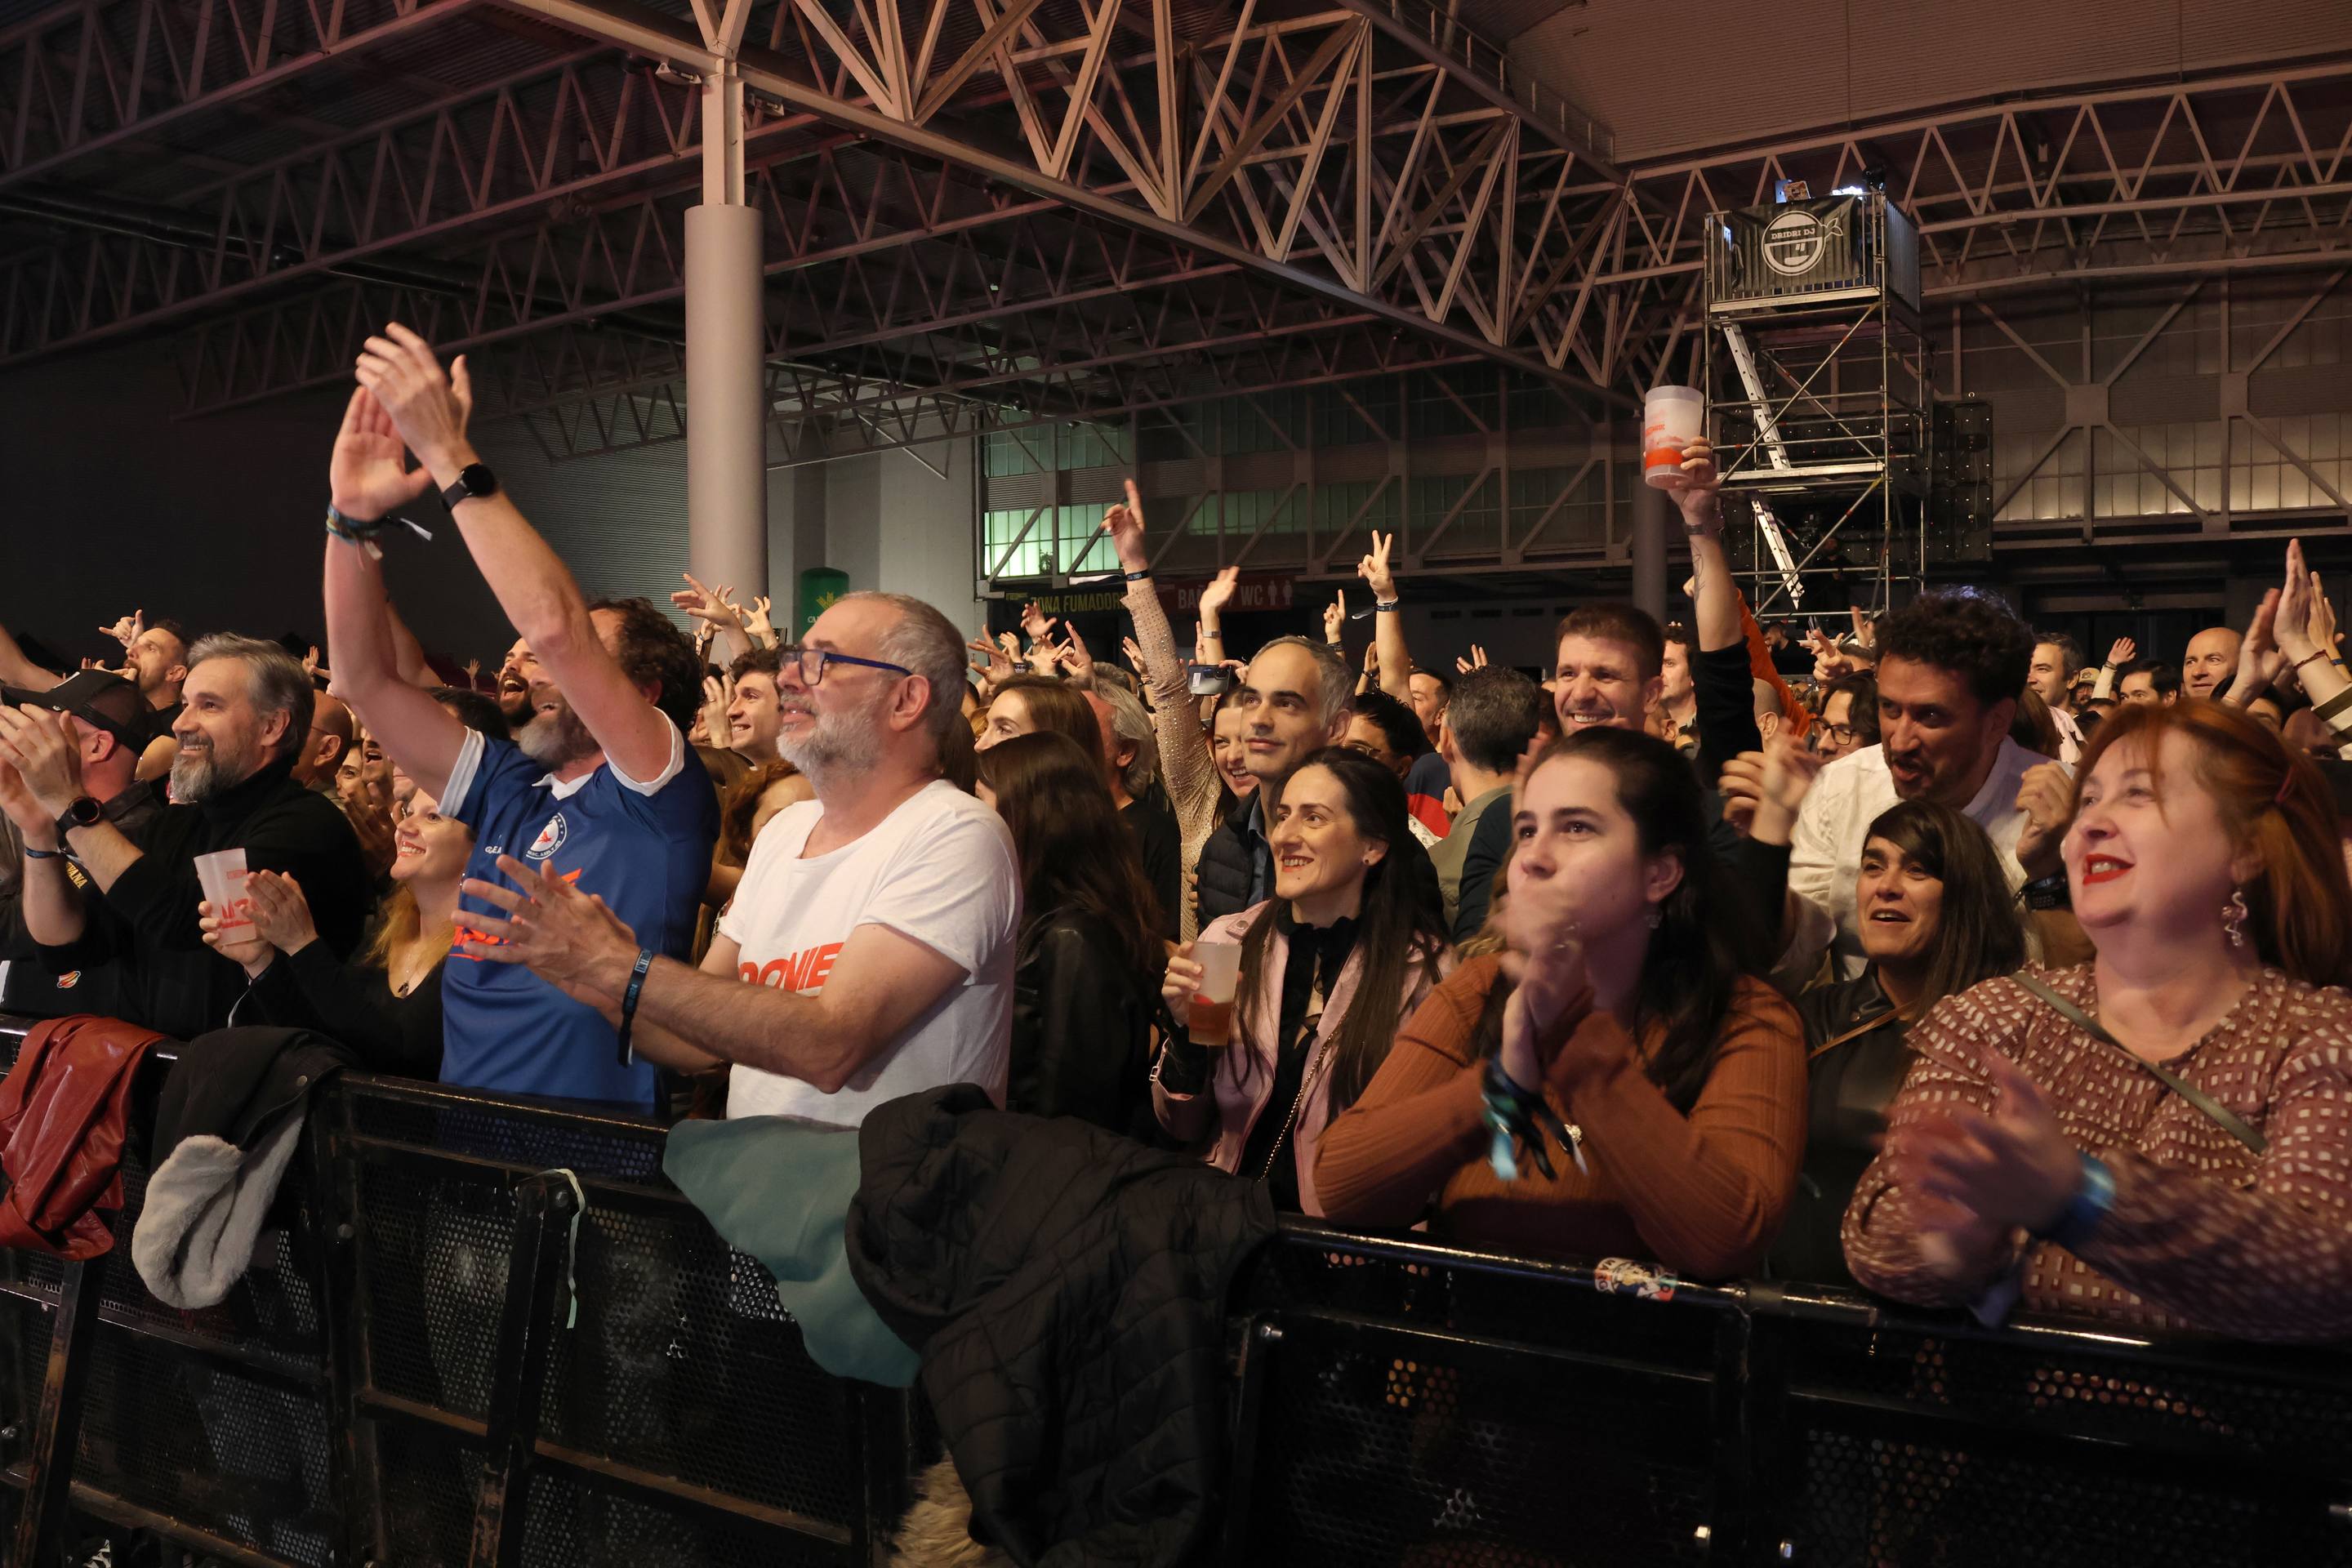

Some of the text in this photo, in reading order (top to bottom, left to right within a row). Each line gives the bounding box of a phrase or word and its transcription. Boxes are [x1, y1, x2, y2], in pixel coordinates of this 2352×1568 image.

[1771, 228, 1815, 240] DRIDRI DJ
[1063, 592, 1126, 612] FUMADOR
[1241, 585, 1263, 606] WC
